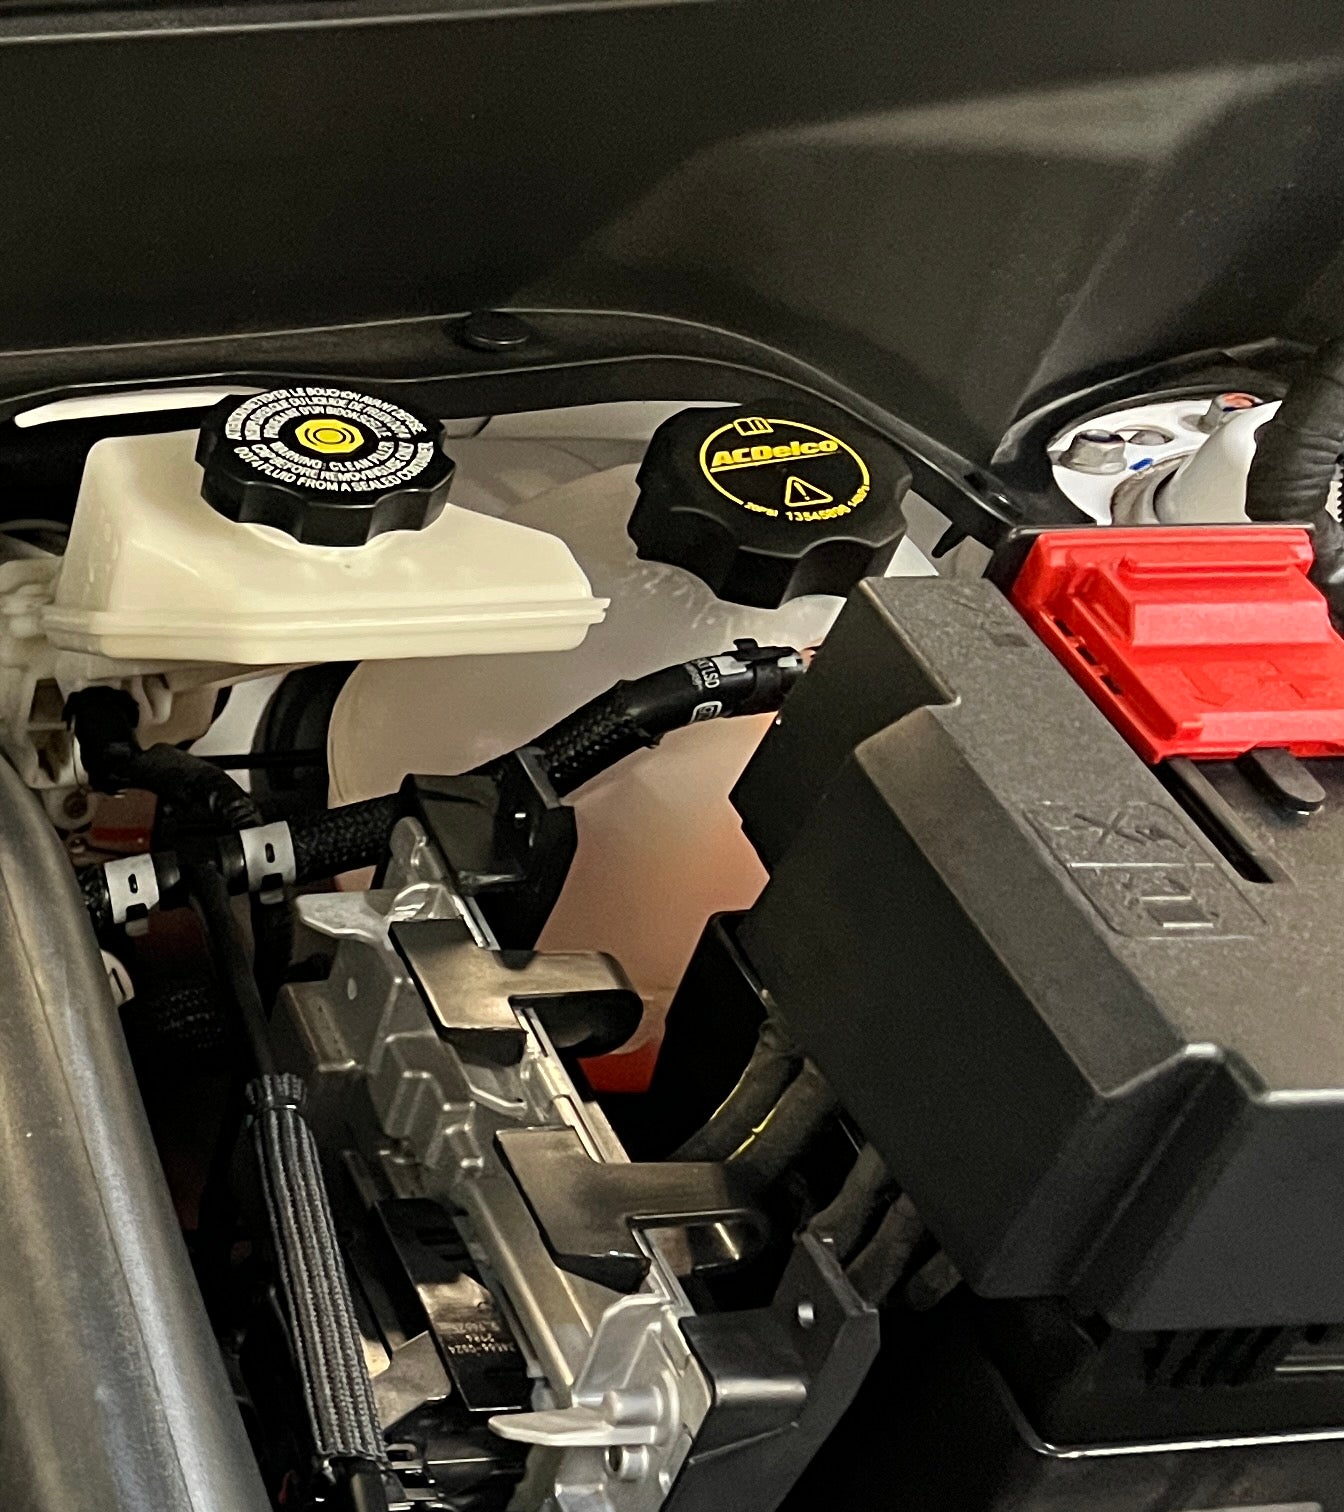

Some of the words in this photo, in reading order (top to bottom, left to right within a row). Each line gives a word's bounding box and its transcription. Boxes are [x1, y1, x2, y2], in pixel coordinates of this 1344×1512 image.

[329, 458, 374, 471] CLEAN
[712, 440, 839, 467] ACDelco
[257, 463, 297, 482] FLUID
[296, 477, 338, 491] FROM
[341, 482, 351, 492] A
[351, 475, 402, 492] SEALED
